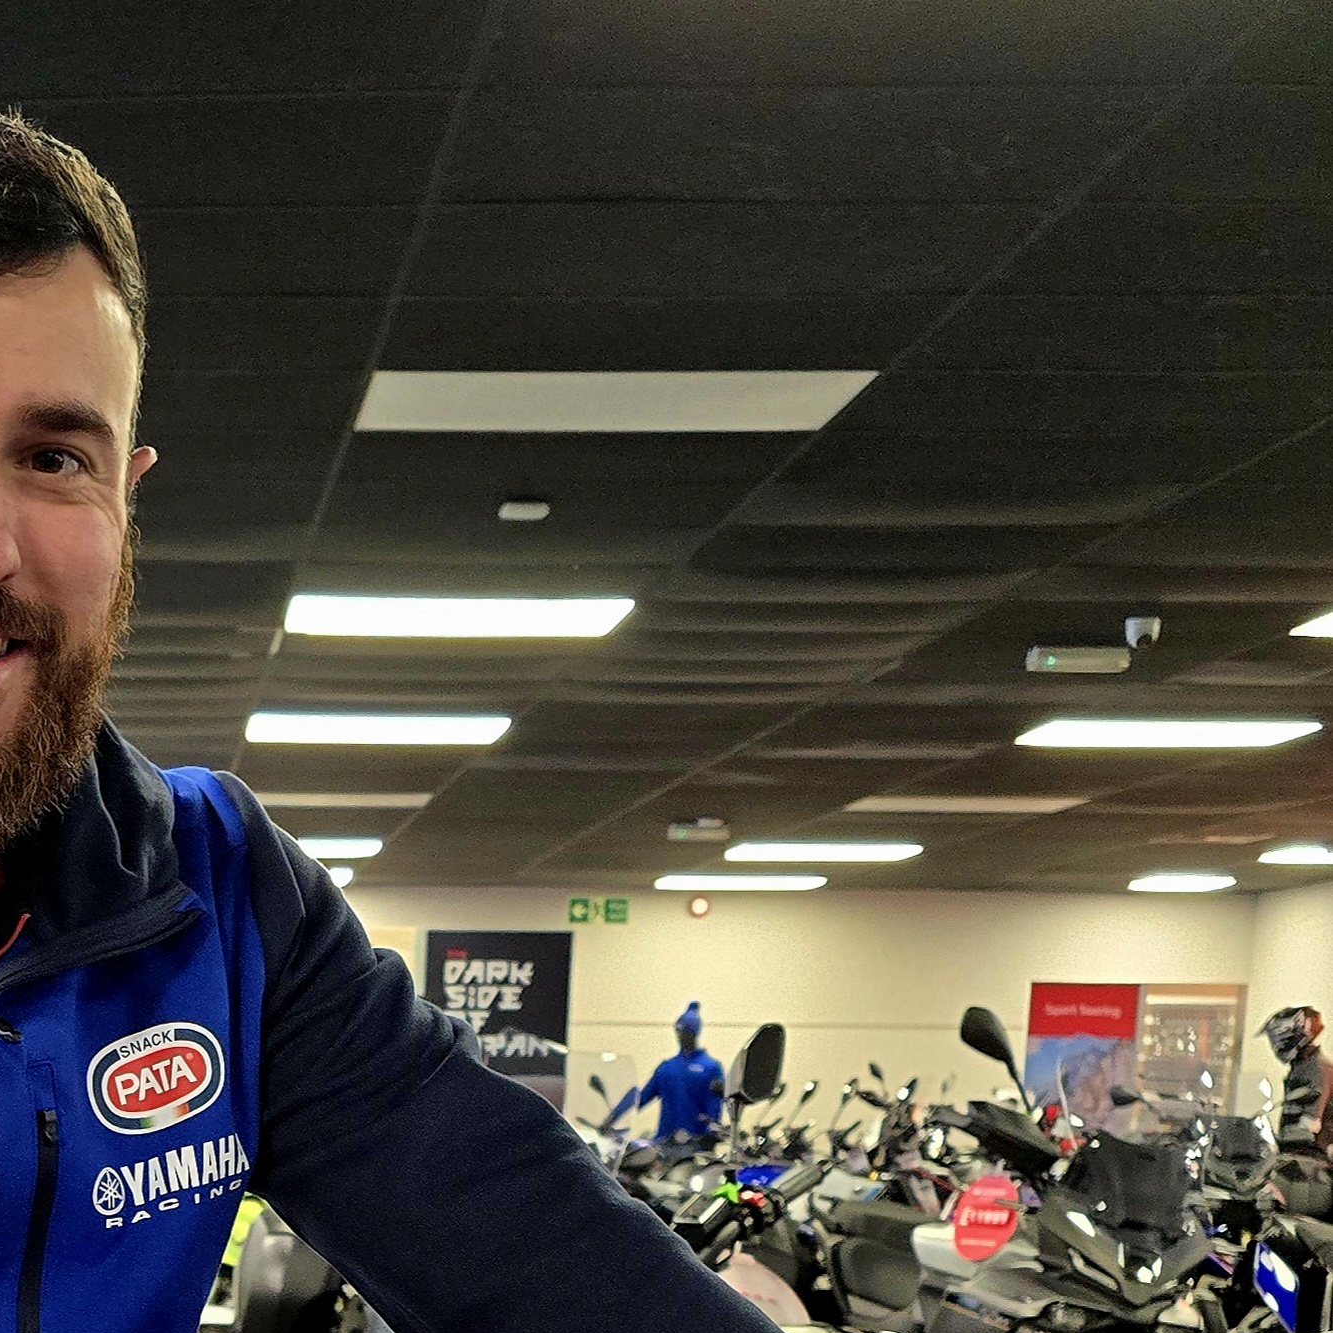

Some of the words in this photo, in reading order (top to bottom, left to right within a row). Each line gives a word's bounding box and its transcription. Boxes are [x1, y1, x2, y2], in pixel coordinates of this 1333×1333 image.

[444, 959, 535, 986] DARK
[119, 1029, 173, 1059] SNACK
[114, 1054, 198, 1106] PATA
[120, 1132, 251, 1206] YAMAHA
[106, 1178, 243, 1229] RACING
